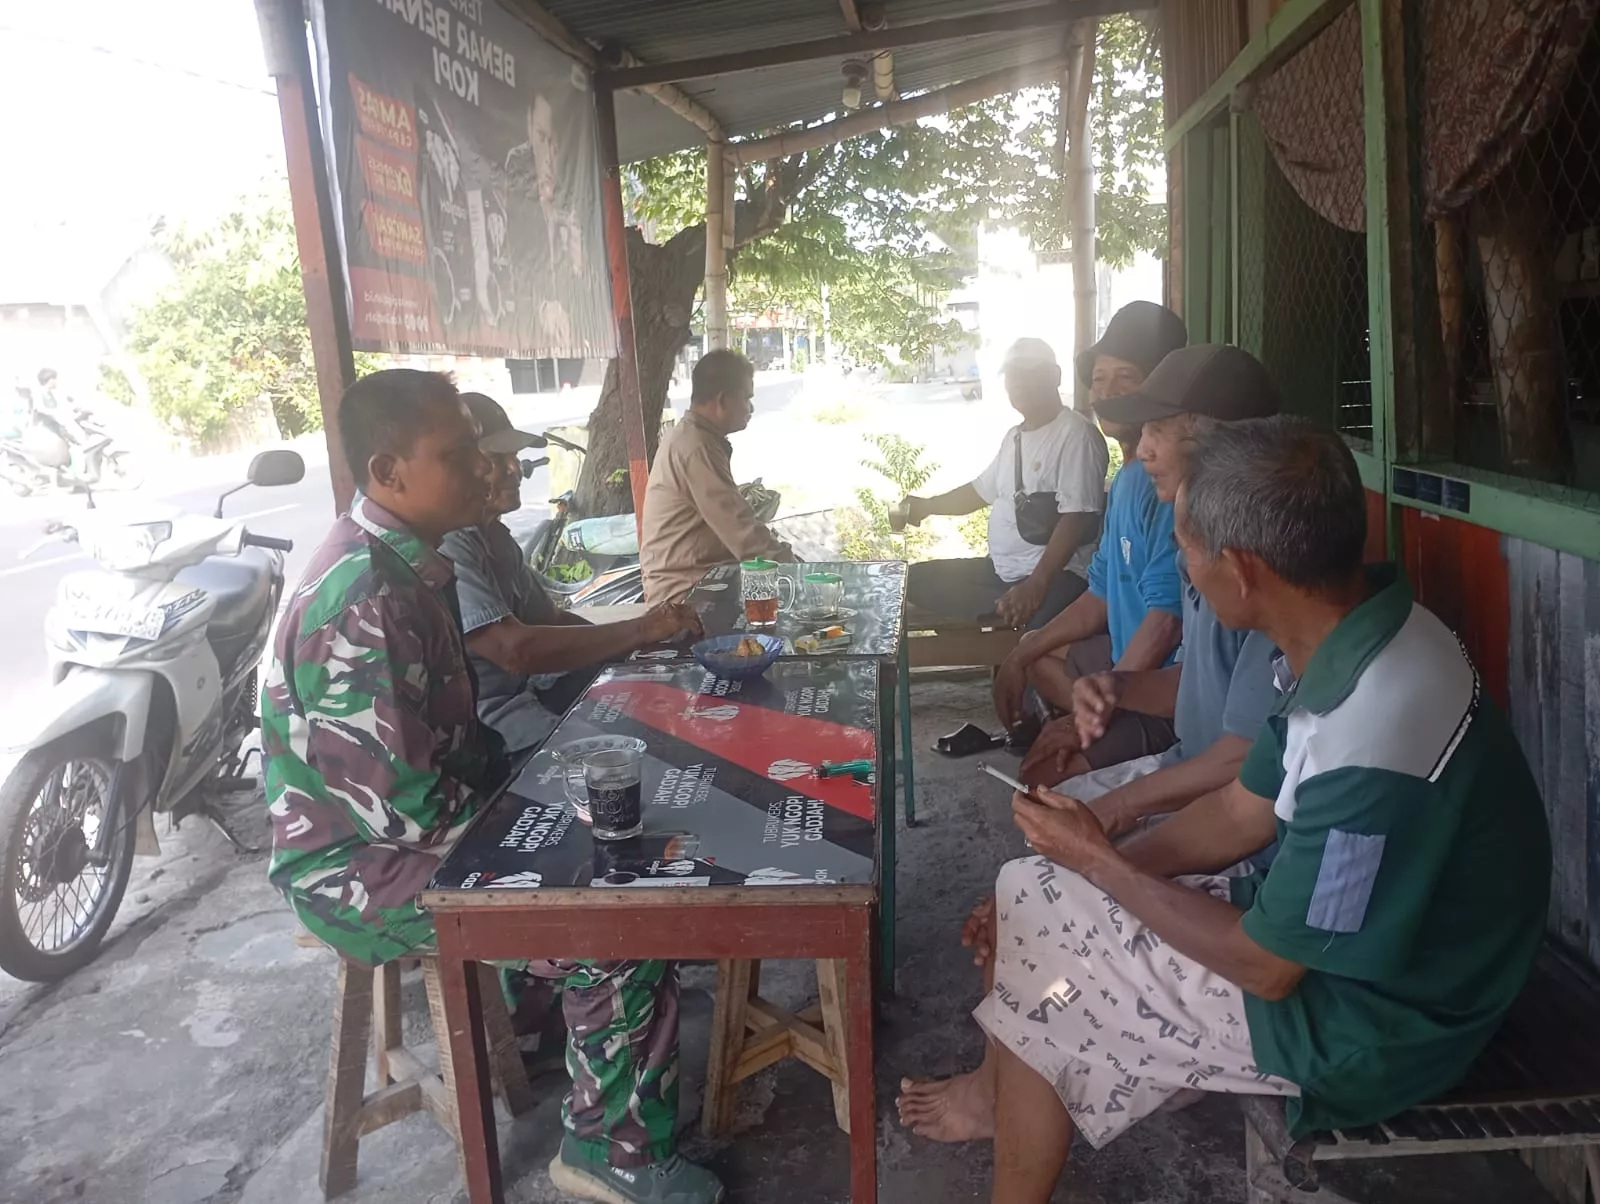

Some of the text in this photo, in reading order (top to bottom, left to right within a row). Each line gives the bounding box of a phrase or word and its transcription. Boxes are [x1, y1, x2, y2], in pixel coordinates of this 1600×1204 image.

[652, 768, 682, 805] GADJAH!
[670, 763, 704, 809] YUK NGOPI
[499, 806, 541, 848] GADJAH!
[539, 801, 565, 820] YUK
[780, 795, 805, 848] YUK NGOPI
[804, 799, 824, 841] GADJAH!
[517, 822, 552, 853] NGOPI
[1124, 930, 1165, 958] ILA
[995, 981, 1021, 1014] FILA
[1026, 977, 1083, 1024] FILA
[1120, 1030, 1146, 1044] FILA
[1104, 1074, 1141, 1114] FILA
